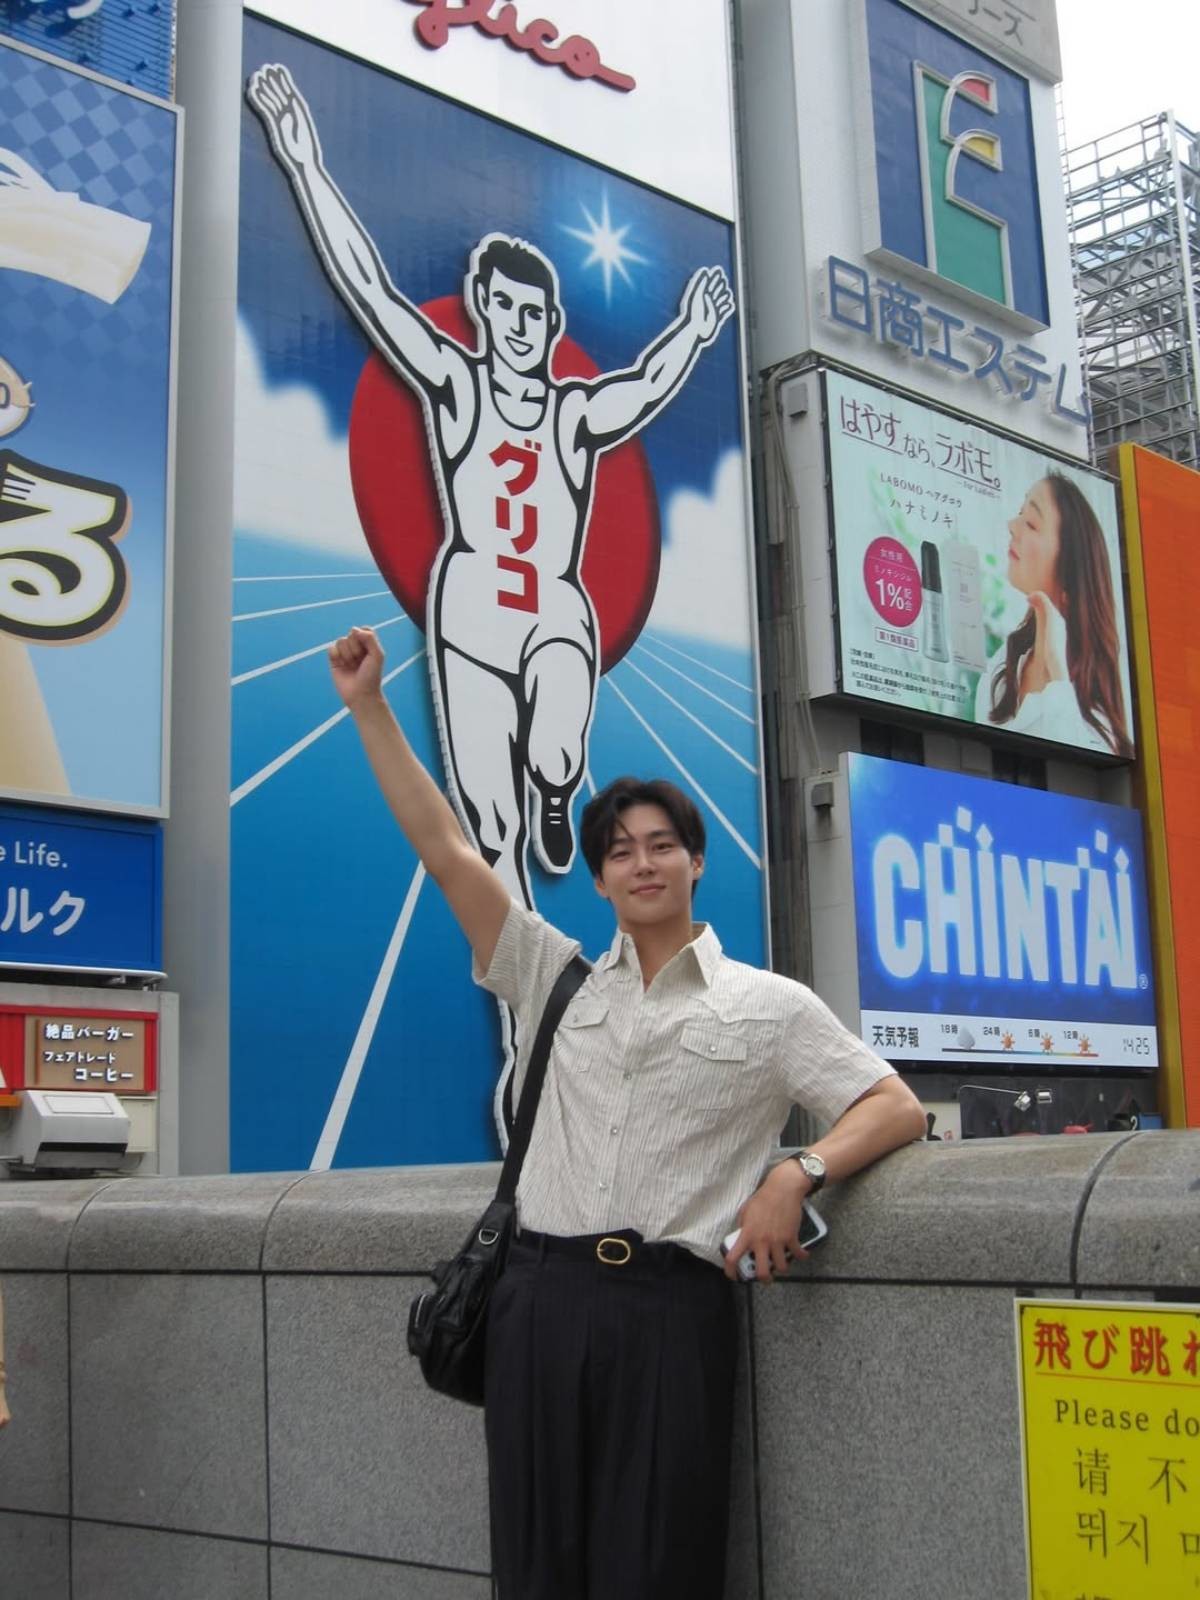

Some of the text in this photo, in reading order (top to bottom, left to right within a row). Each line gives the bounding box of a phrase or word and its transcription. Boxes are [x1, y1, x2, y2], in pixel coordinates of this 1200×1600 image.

[402, 0, 636, 92] ico
[880, 472, 924, 495] LABOMO
[489, 439, 542, 614] グリコ
[14, 840, 68, 869] Life.
[44, 1023, 134, 1041] 絶品バーガー
[872, 1025, 919, 1047] 天気予報
[44, 1051, 116, 1065] フェアトレード
[75, 1067, 134, 1082] コーヒー
[1056, 1400, 1200, 1437] Please do
